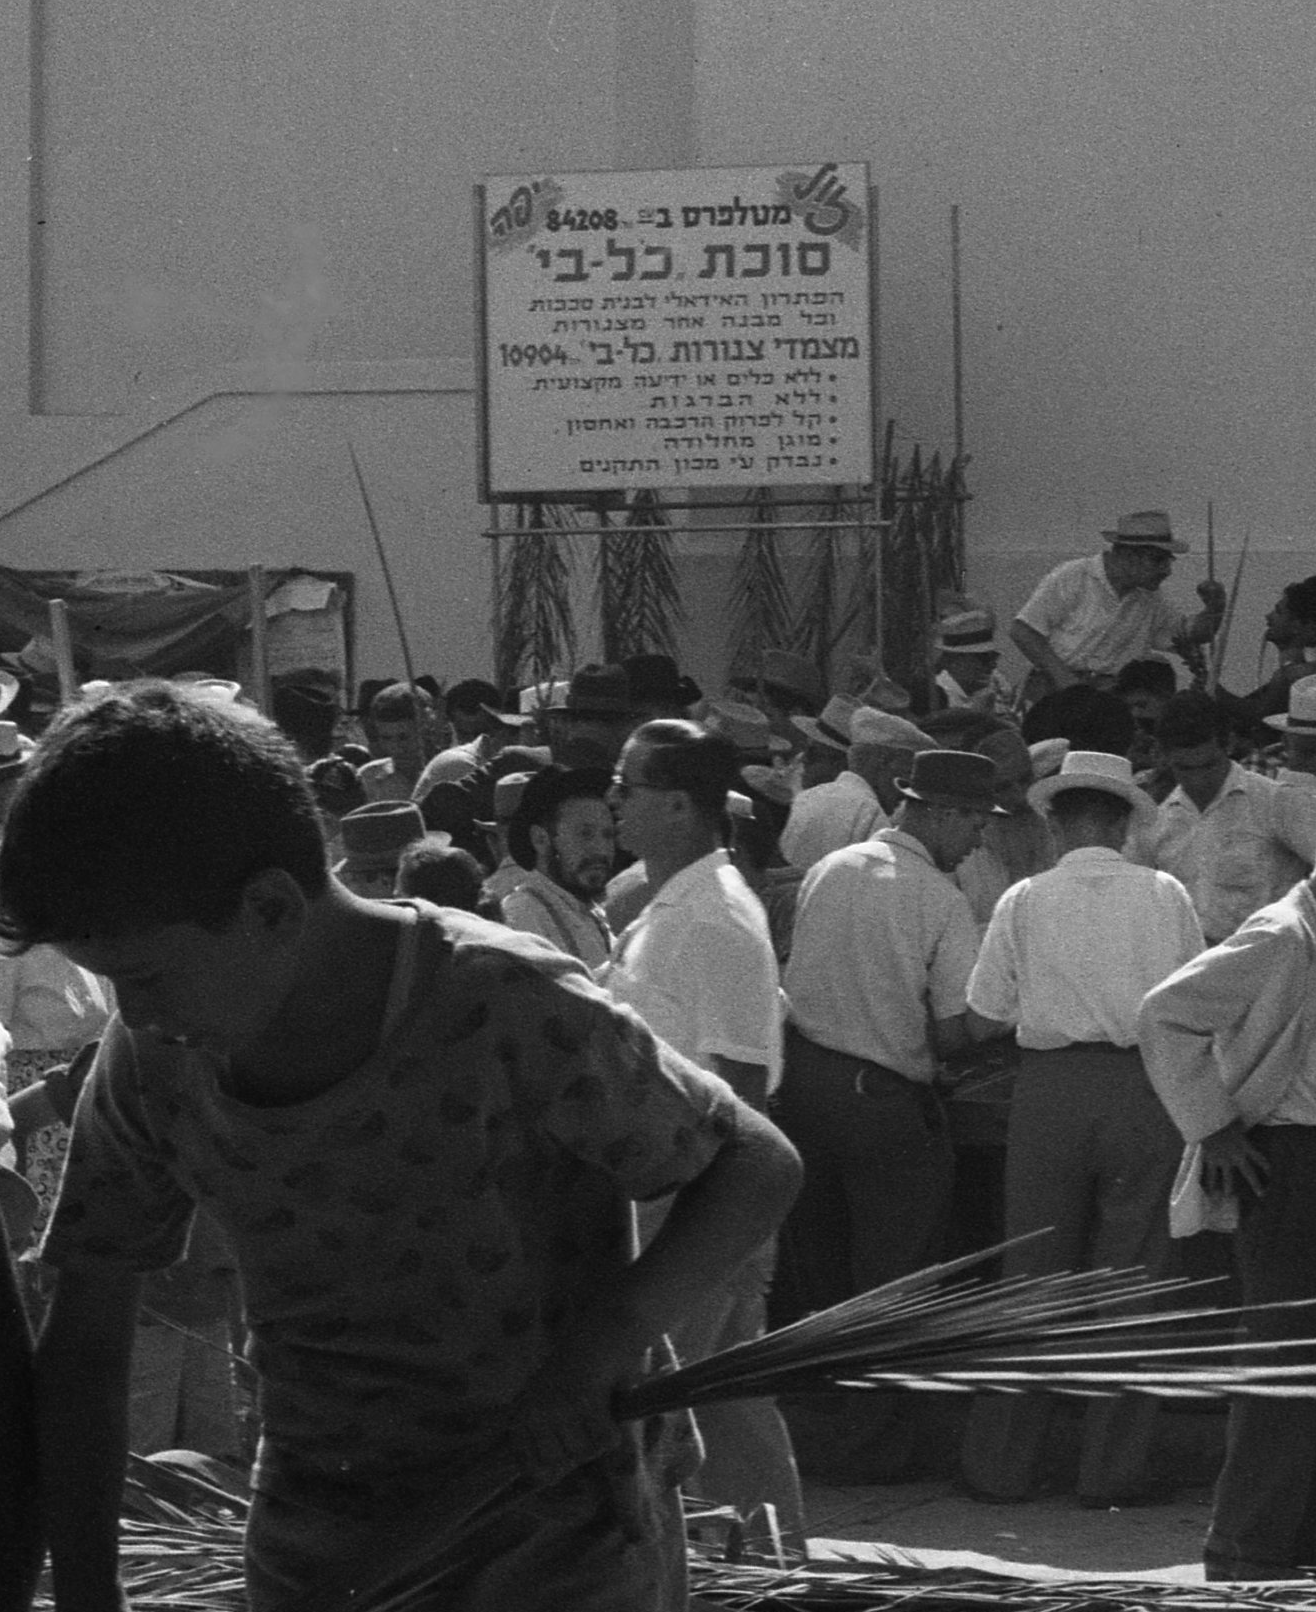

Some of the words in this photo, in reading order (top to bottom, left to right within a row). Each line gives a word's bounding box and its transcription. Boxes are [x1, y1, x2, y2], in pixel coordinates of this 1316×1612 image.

[546, 208, 618, 232] 84208
[681, 196, 792, 228] מטלפרס
[697, 242, 831, 279] סוכת
[528, 298, 593, 312] סככות
[600, 292, 656, 310] לבנית
[664, 291, 748, 309] האידאלי
[761, 291, 844, 309] הפתרון
[553, 318, 646, 333] מצנורות
[663, 316, 704, 330] אחר
[721, 314, 782, 328] מבנה
[799, 310, 836, 325] וכל
[499, 343, 567, 367] 10904
[669, 339, 764, 364] צנורות
[774, 337, 860, 360] מצמדי
[634, 373, 686, 388] ידיעה
[696, 373, 716, 386] או
[727, 368, 775, 386] כלים
[785, 366, 821, 384] ללא
[532, 376, 622, 393] מקצועית
[650, 393, 752, 409] הברגות
[775, 388, 821, 406] ללא
[566, 417, 635, 436] ואחסון
[646, 415, 714, 429] הרכבה
[724, 412, 783, 431] לפרוק
[792, 410, 821, 430] קל
[664, 433, 756, 450] מחלודה
[777, 434, 822, 451] מוגן
[579, 459, 660, 475] התקנים
[674, 458, 719, 475] מכון
[767, 455, 822, 473] נבדק
